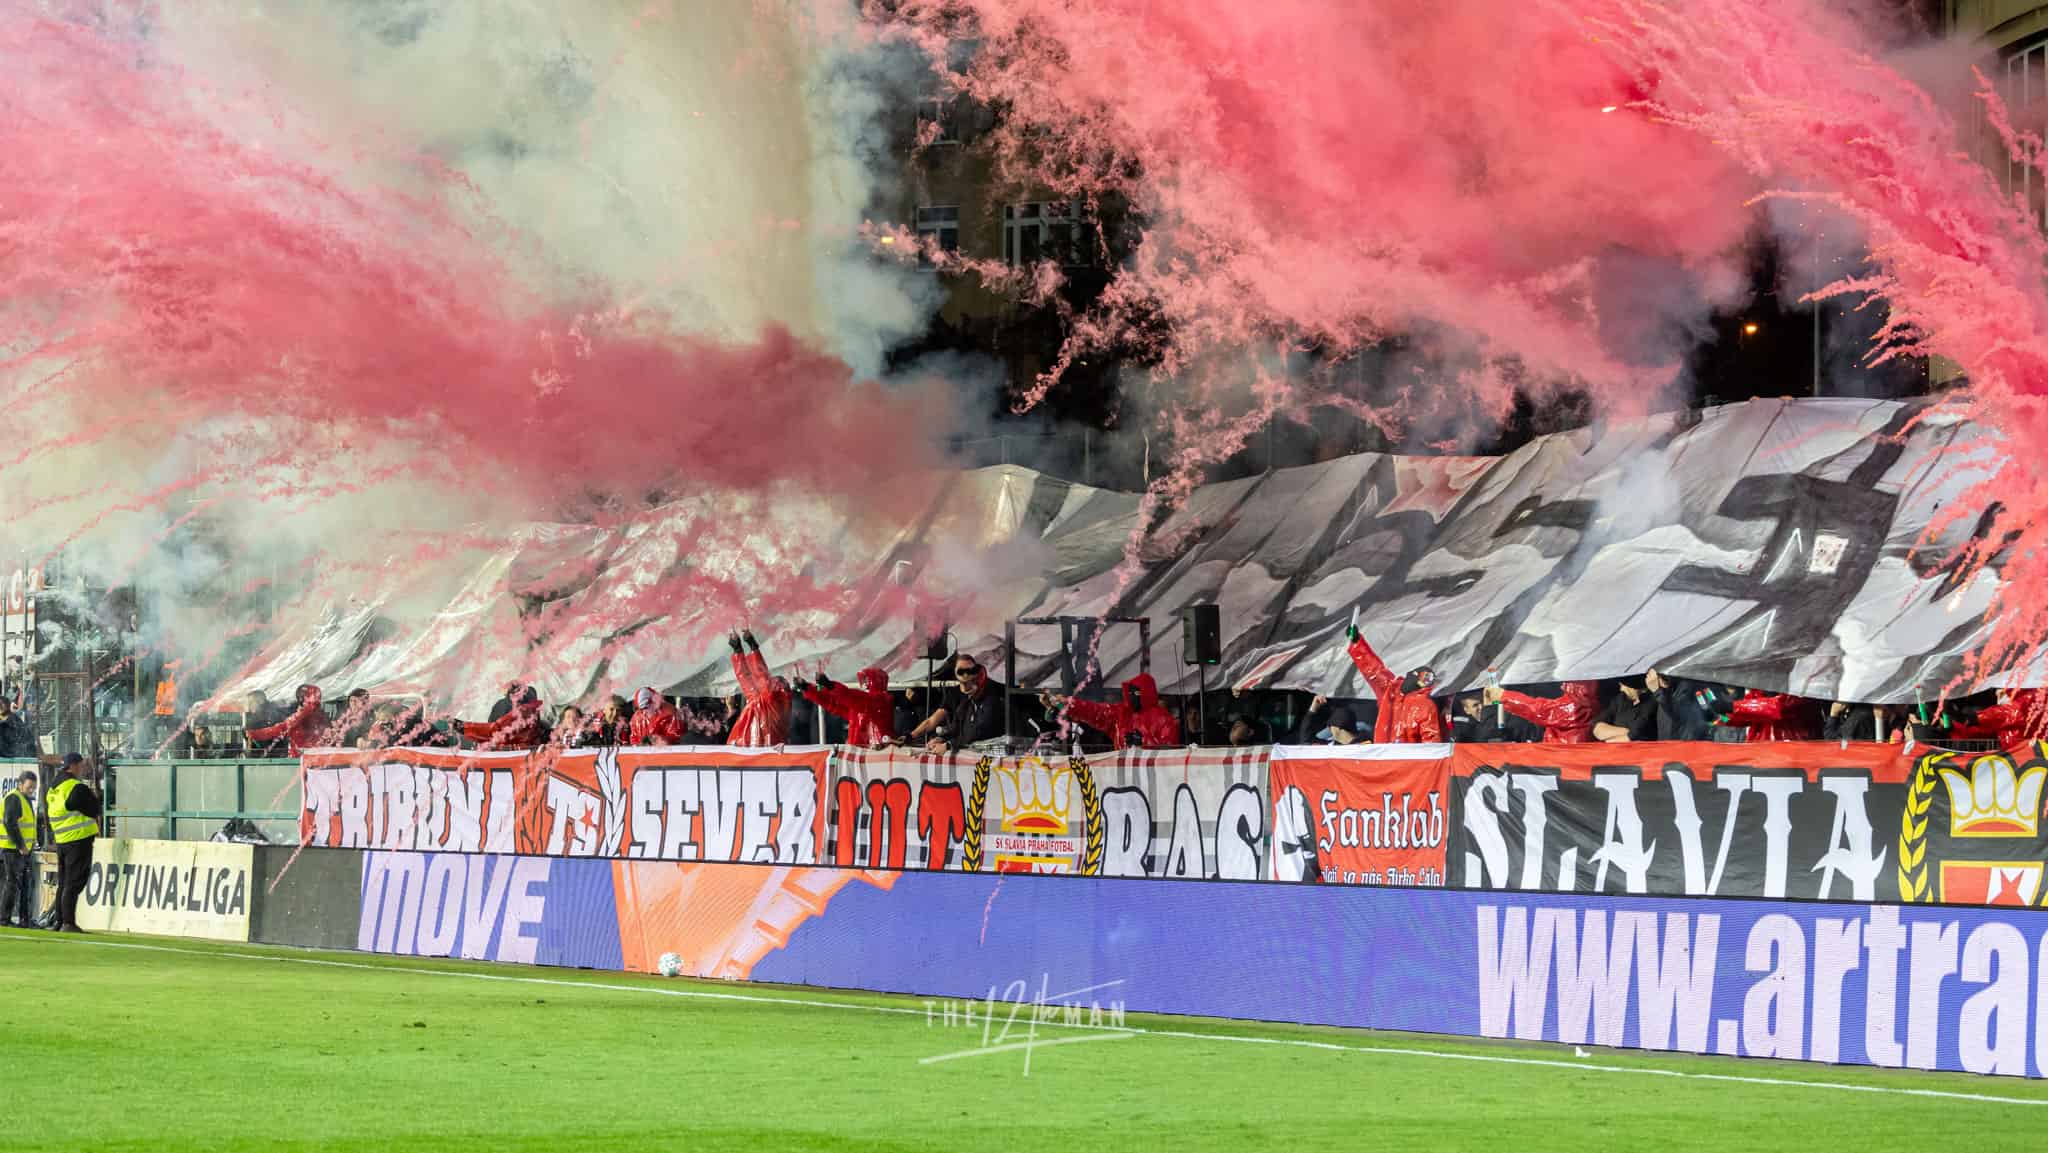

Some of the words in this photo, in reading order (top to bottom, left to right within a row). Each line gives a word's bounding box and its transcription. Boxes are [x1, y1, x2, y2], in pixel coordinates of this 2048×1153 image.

[629, 768, 816, 864] SEVER
[1005, 838, 1026, 850] SLAVIA
[1028, 839, 1049, 851] PRAHA
[1051, 840, 1074, 852] FOTBAL
[1319, 790, 1443, 854] Fanklub
[1464, 770, 1887, 900] SLAVIA
[86, 862, 246, 915] ORTUNA:LIGA
[358, 850, 552, 965] MOVE
[1477, 904, 2048, 1079] www.artra
